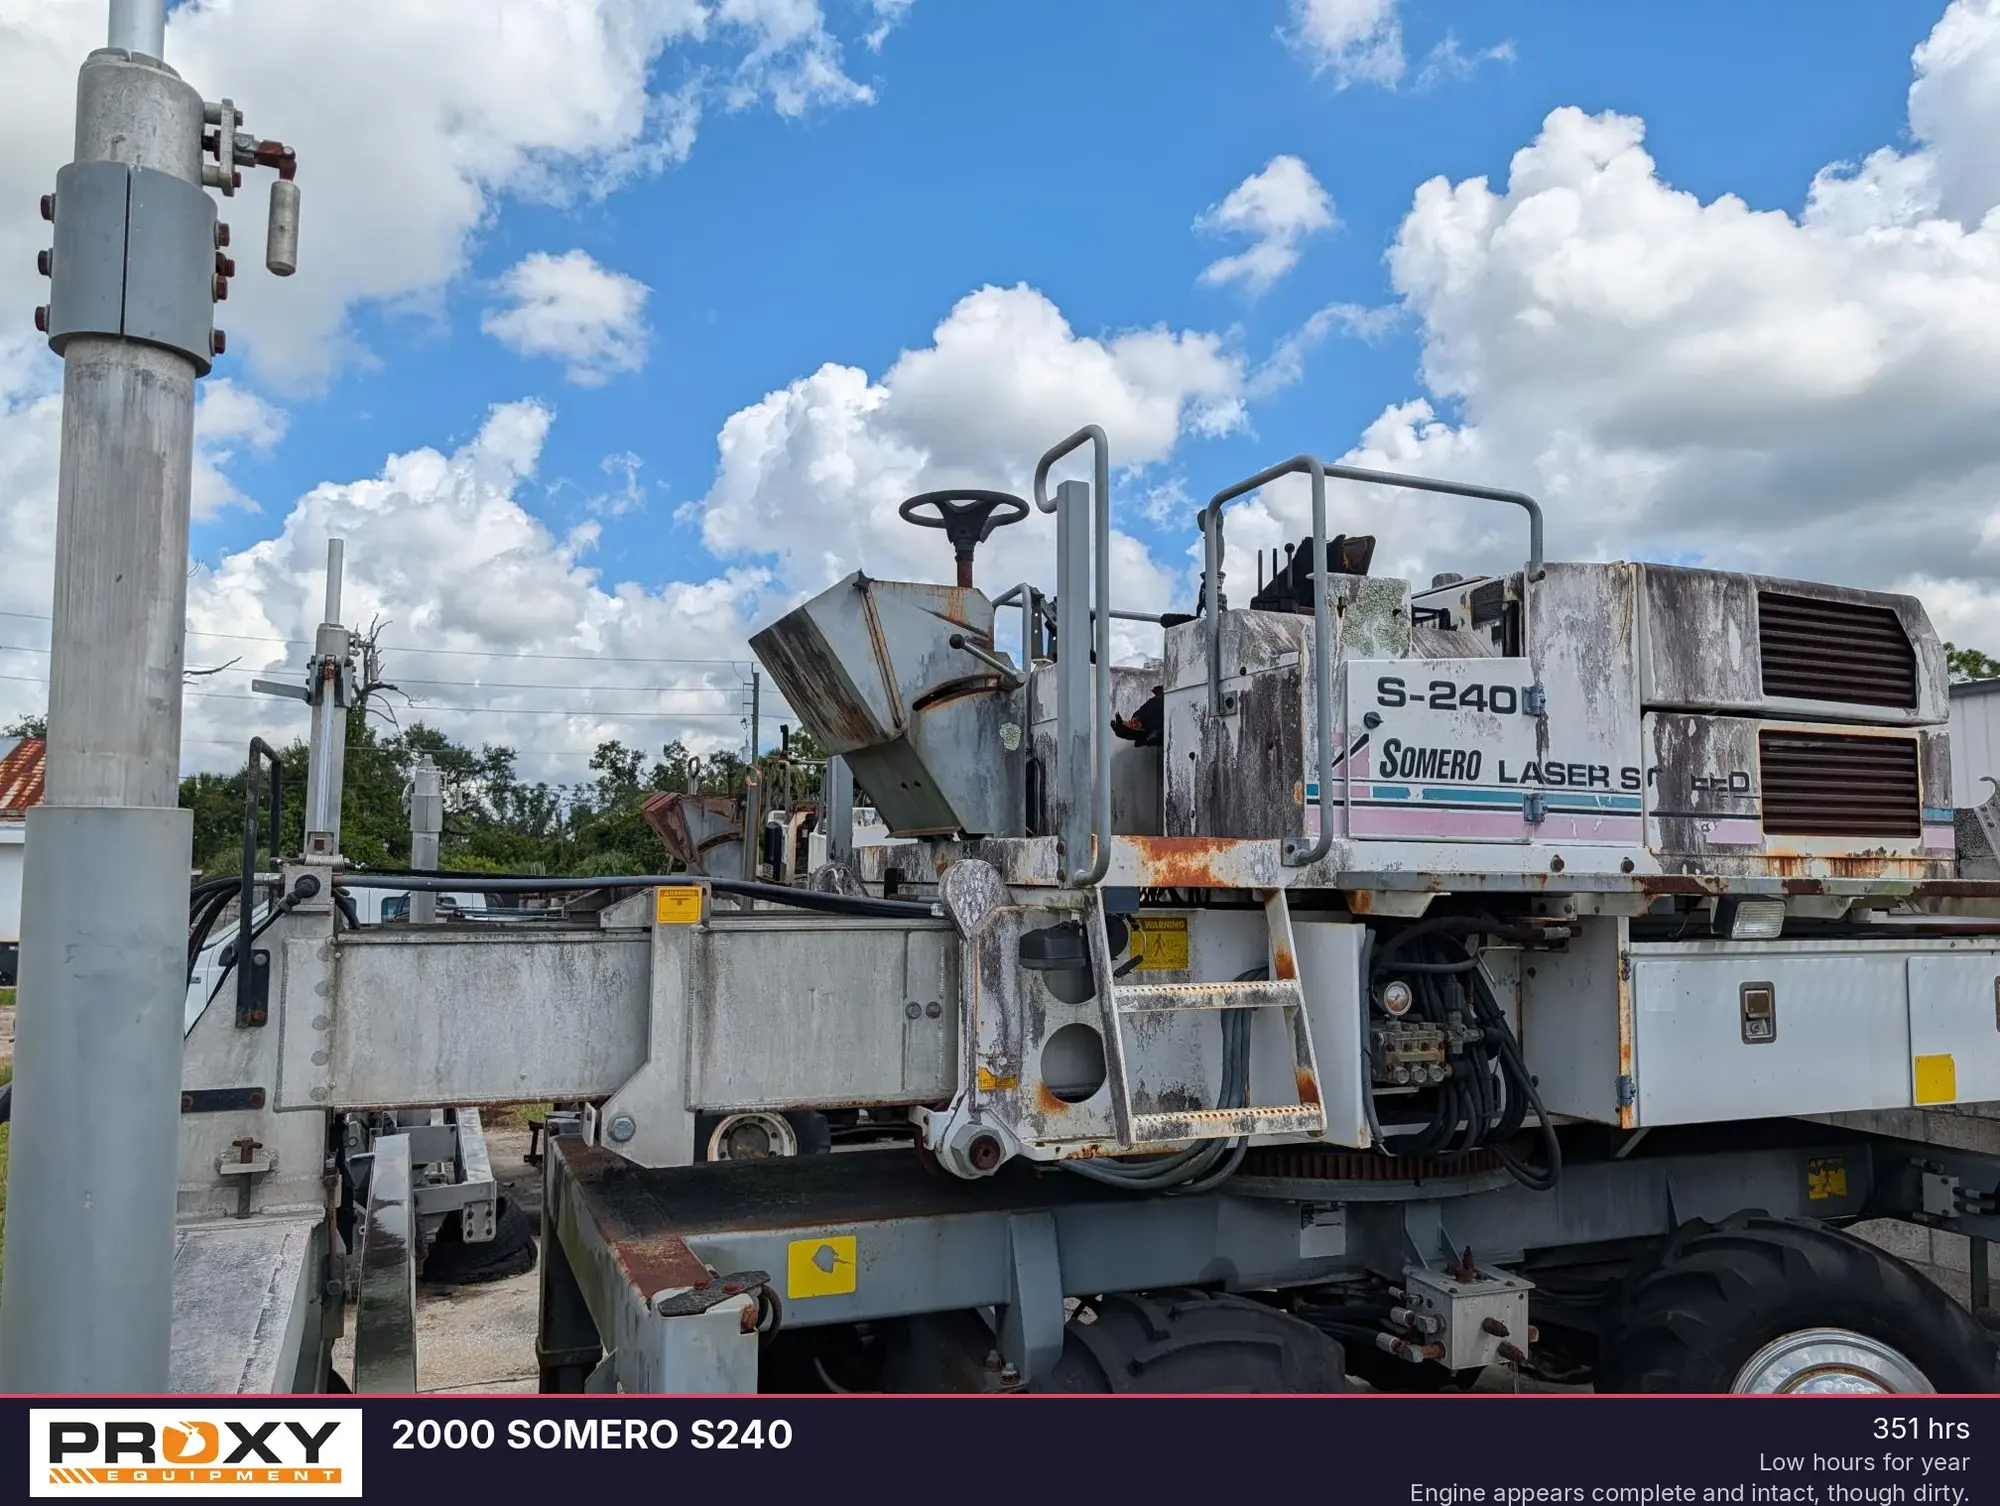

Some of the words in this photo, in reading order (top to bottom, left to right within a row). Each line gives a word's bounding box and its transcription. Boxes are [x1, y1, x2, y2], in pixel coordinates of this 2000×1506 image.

[1377, 676, 1517, 714] S-240
[1379, 738, 1482, 781] SOMERO
[1499, 760, 1610, 788] LASER
[1144, 920, 1185, 929] WARNING
